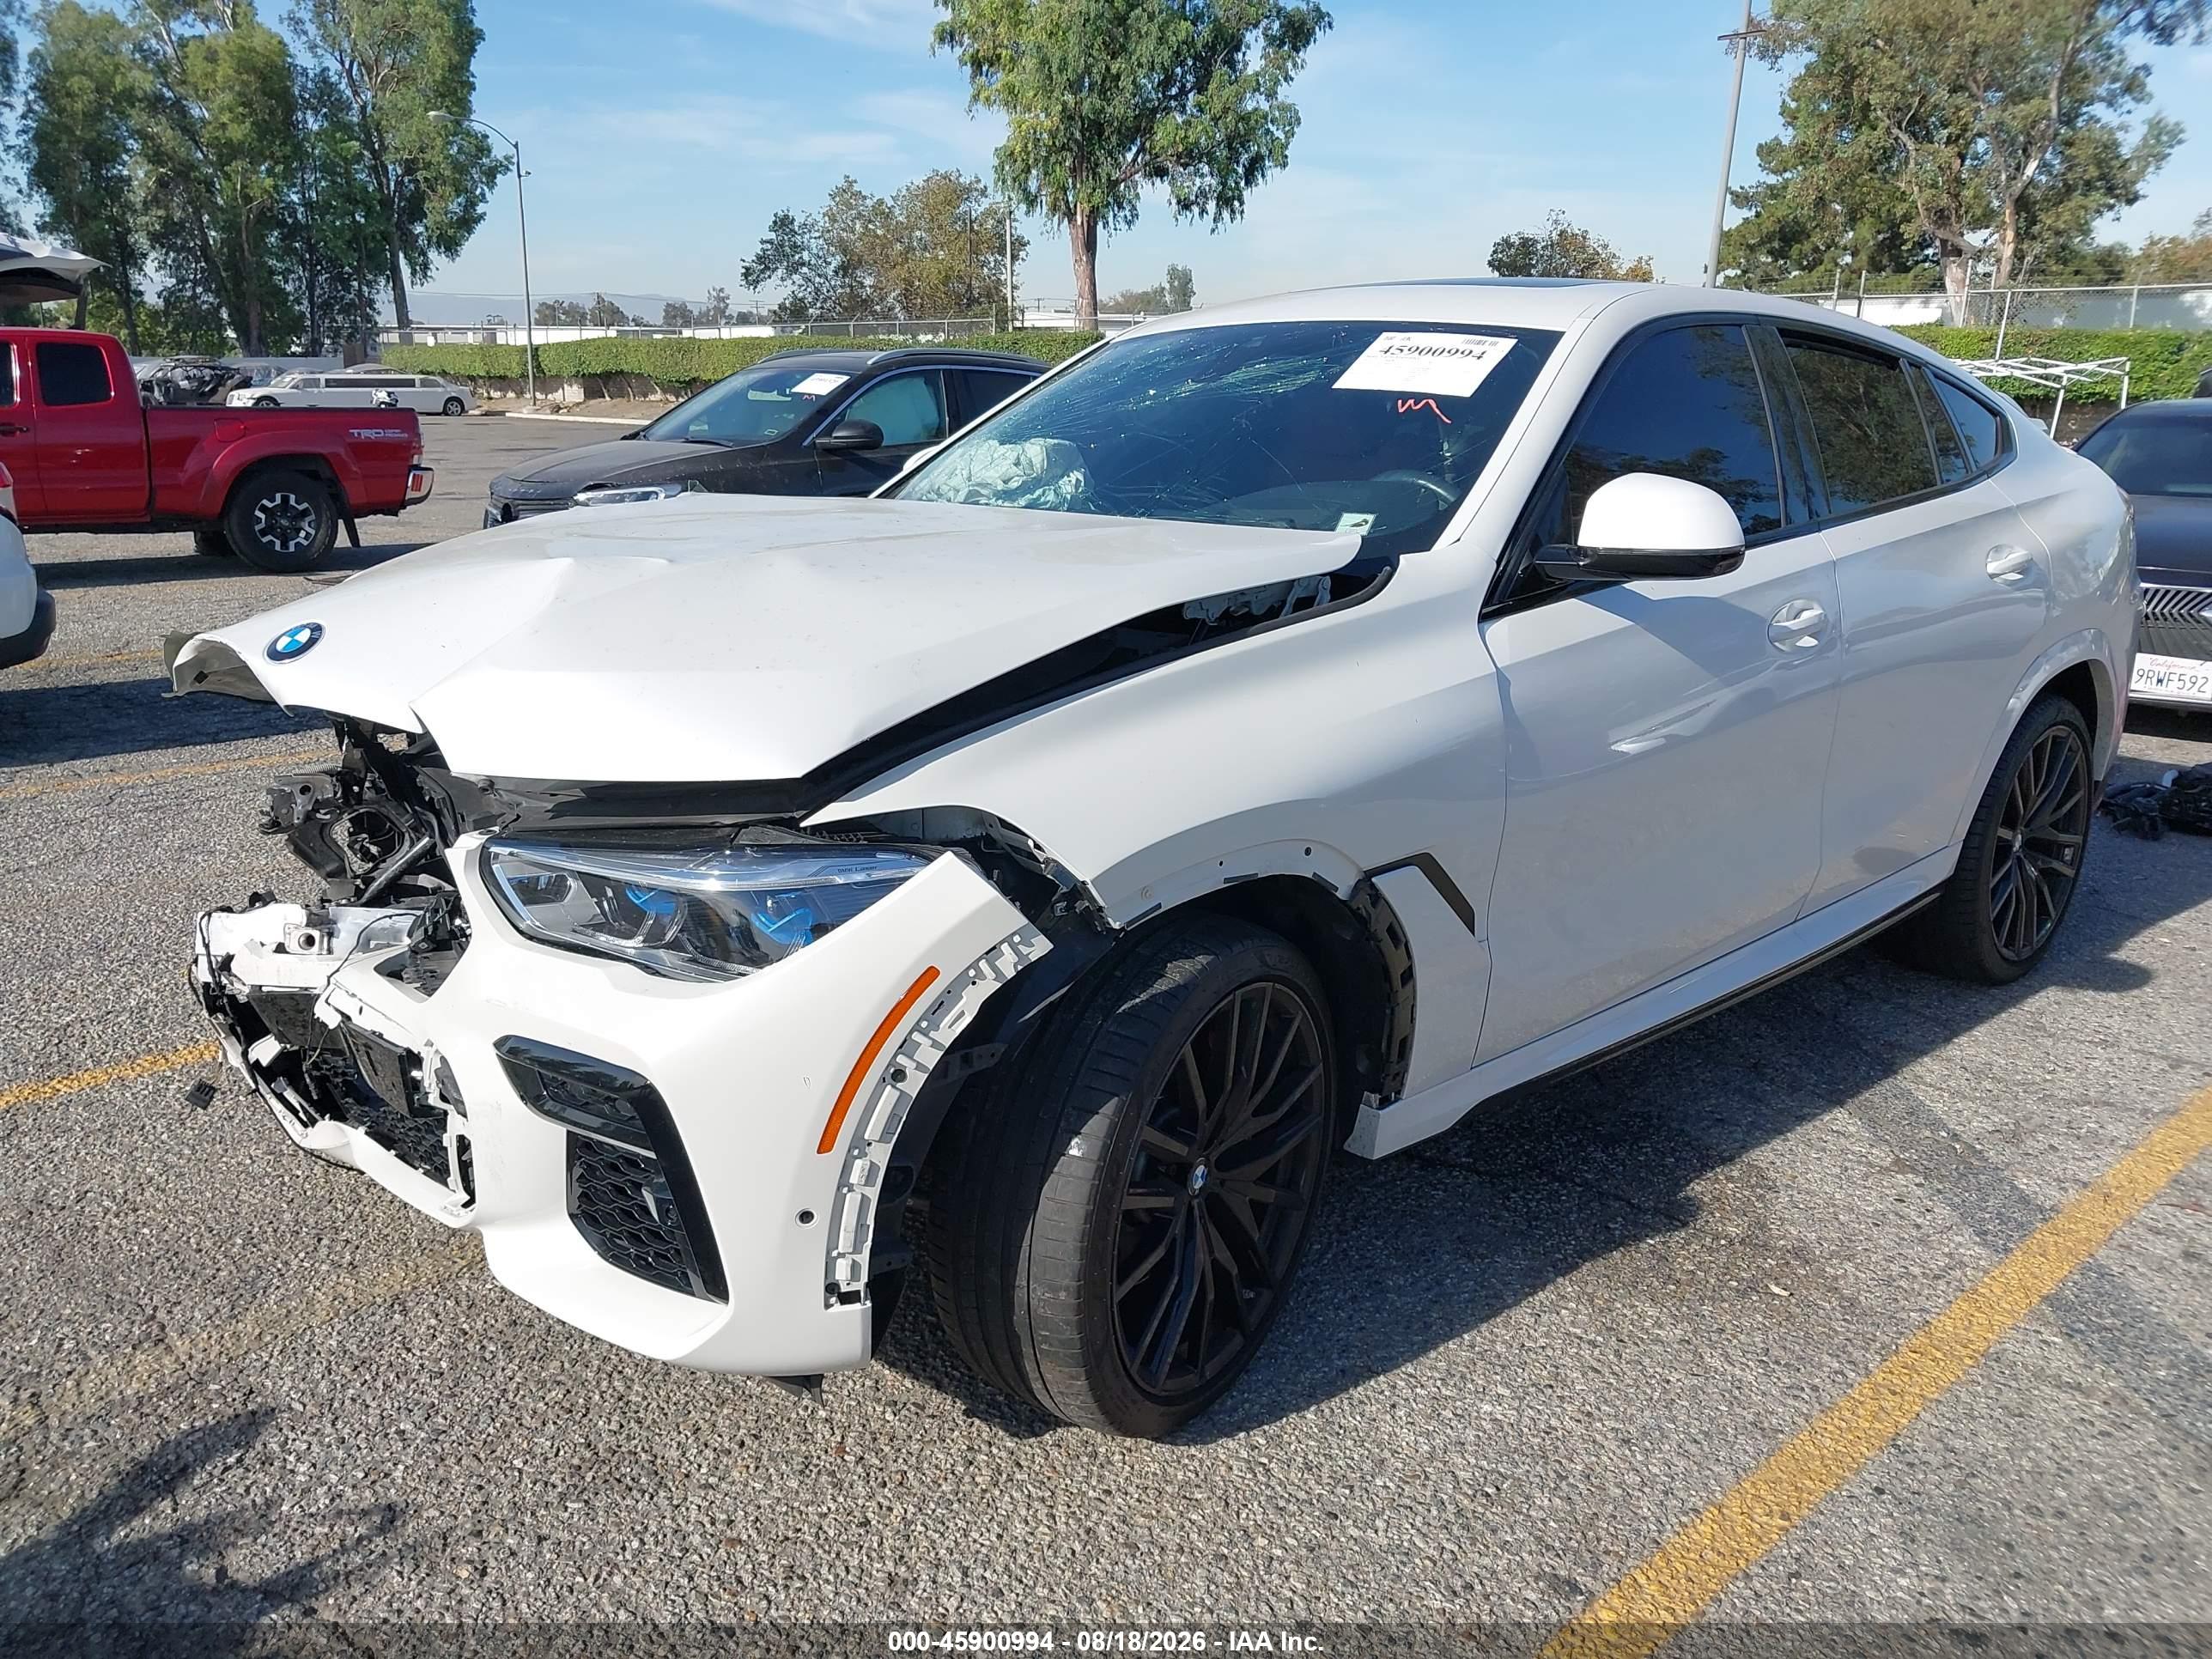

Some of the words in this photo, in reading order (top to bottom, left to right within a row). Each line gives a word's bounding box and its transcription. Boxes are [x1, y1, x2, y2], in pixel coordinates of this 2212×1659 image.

[1379, 343, 1487, 360] 45900994
[349, 428, 384, 439] TRD
[2134, 668, 2209, 693] 9RWF592
